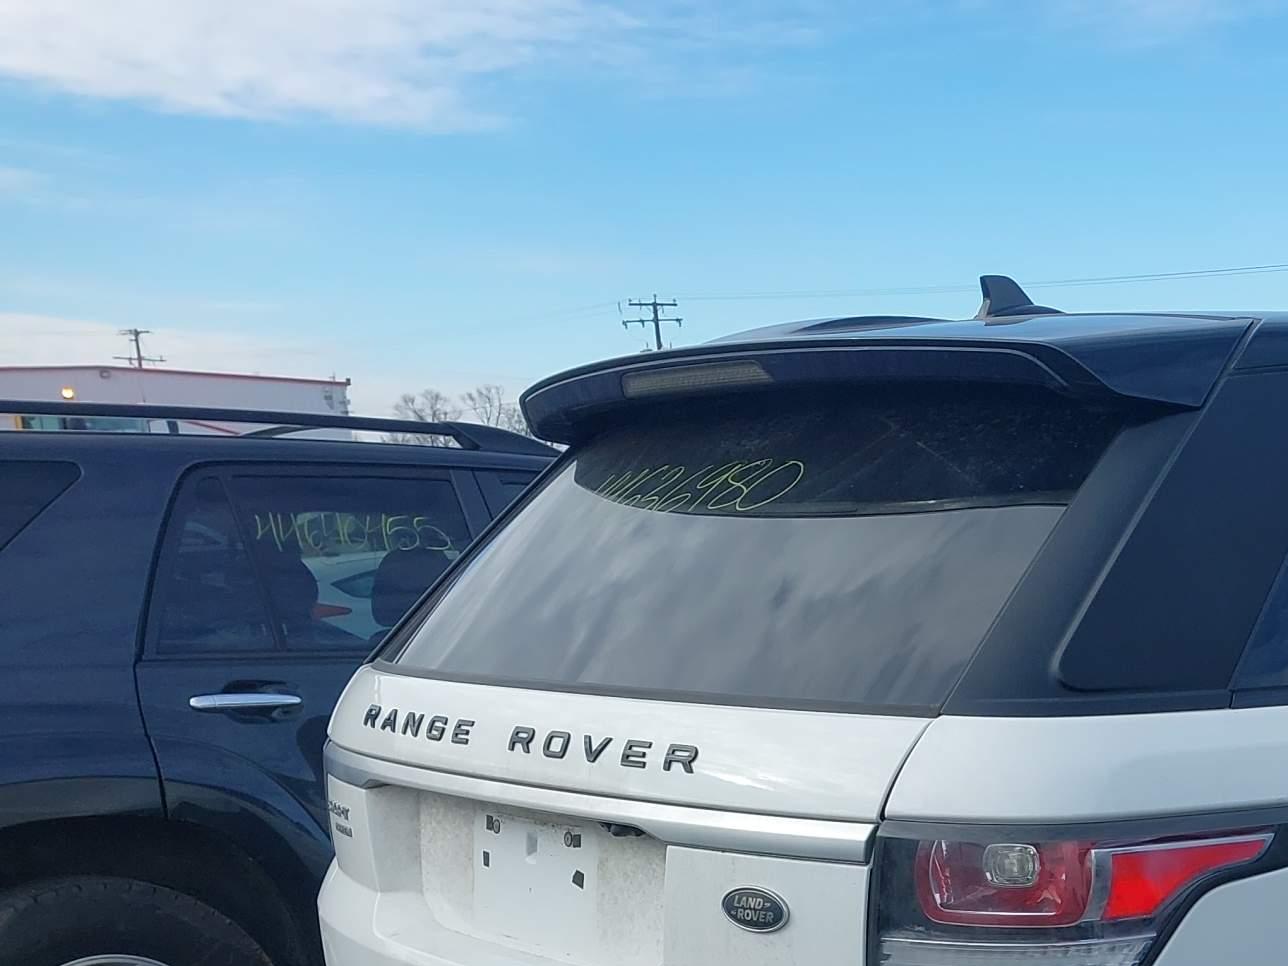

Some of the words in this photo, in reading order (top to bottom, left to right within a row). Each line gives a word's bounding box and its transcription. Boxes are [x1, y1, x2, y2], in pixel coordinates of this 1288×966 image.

[362, 703, 475, 746] RANGE
[507, 725, 700, 774] ROVER
[733, 895, 764, 909] LAND
[737, 908, 775, 922] ROVER
